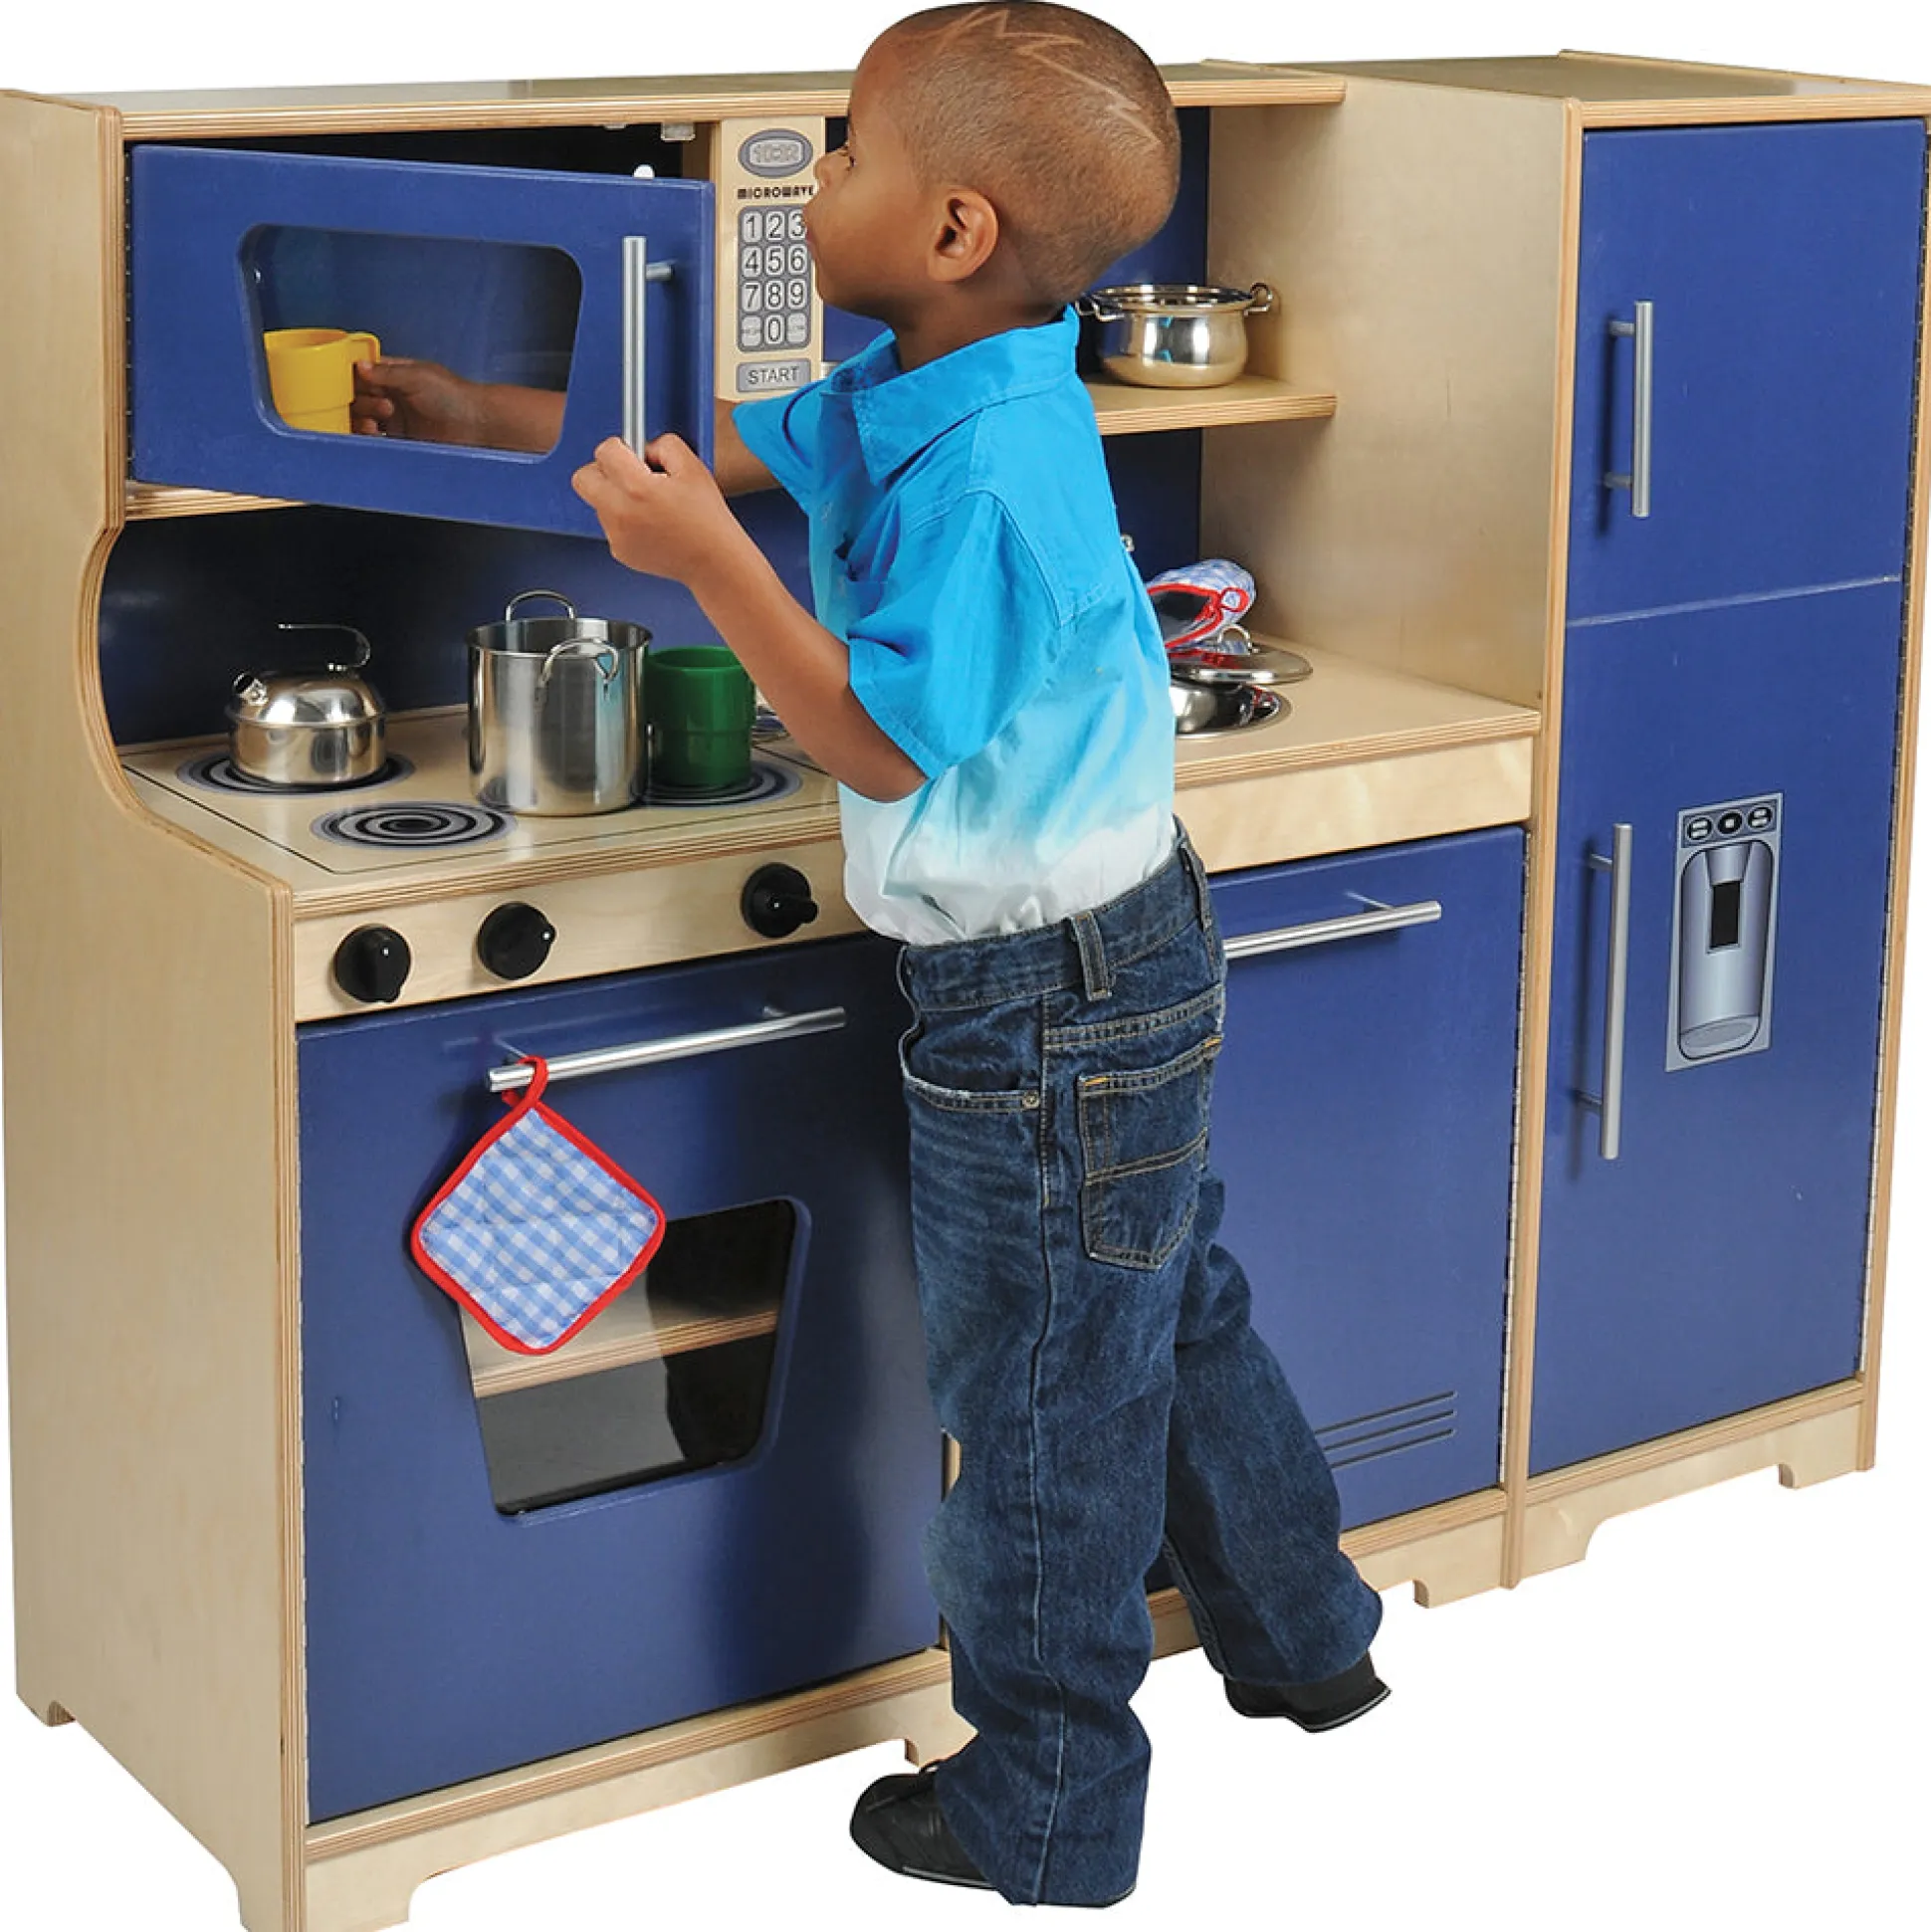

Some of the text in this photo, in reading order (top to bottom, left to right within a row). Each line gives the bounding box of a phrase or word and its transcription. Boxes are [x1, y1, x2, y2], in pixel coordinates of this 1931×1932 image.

[746, 212, 805, 239] 1 2 3
[745, 246, 804, 274] 4 5 6
[745, 281, 804, 309] 7 8 9
[767, 317, 781, 341] 0
[748, 365, 799, 384] START
